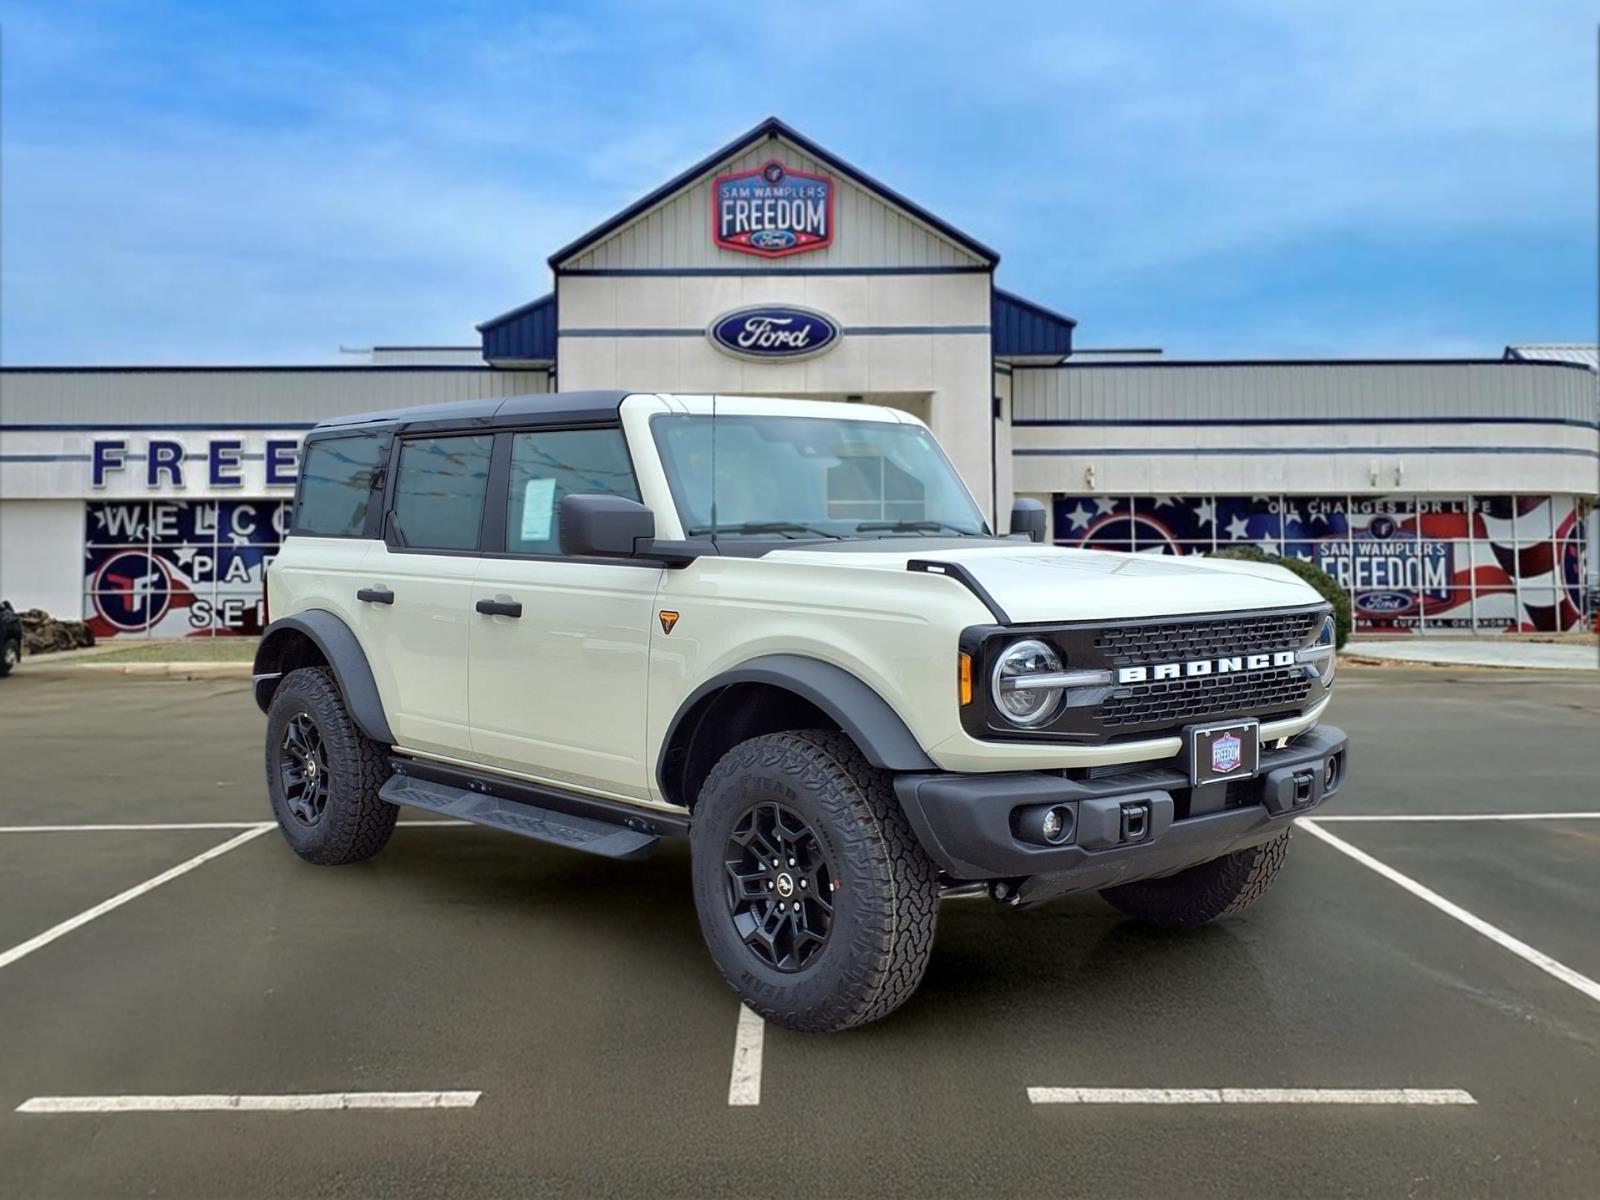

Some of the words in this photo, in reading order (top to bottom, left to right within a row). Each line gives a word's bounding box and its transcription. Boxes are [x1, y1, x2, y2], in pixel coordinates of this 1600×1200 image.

[722, 187, 750, 198] SAM
[721, 200, 825, 236] FREEDOM
[737, 316, 811, 347] Ford
[1267, 501, 1299, 514] OIL
[1307, 500, 1397, 514] CHANGES
[1405, 500, 1442, 513] FOR
[1451, 500, 1491, 513] LIFE
[1321, 556, 1447, 598] FREEDOM
[1366, 595, 1401, 610] Ford
[1118, 650, 1295, 684] BRONCO
